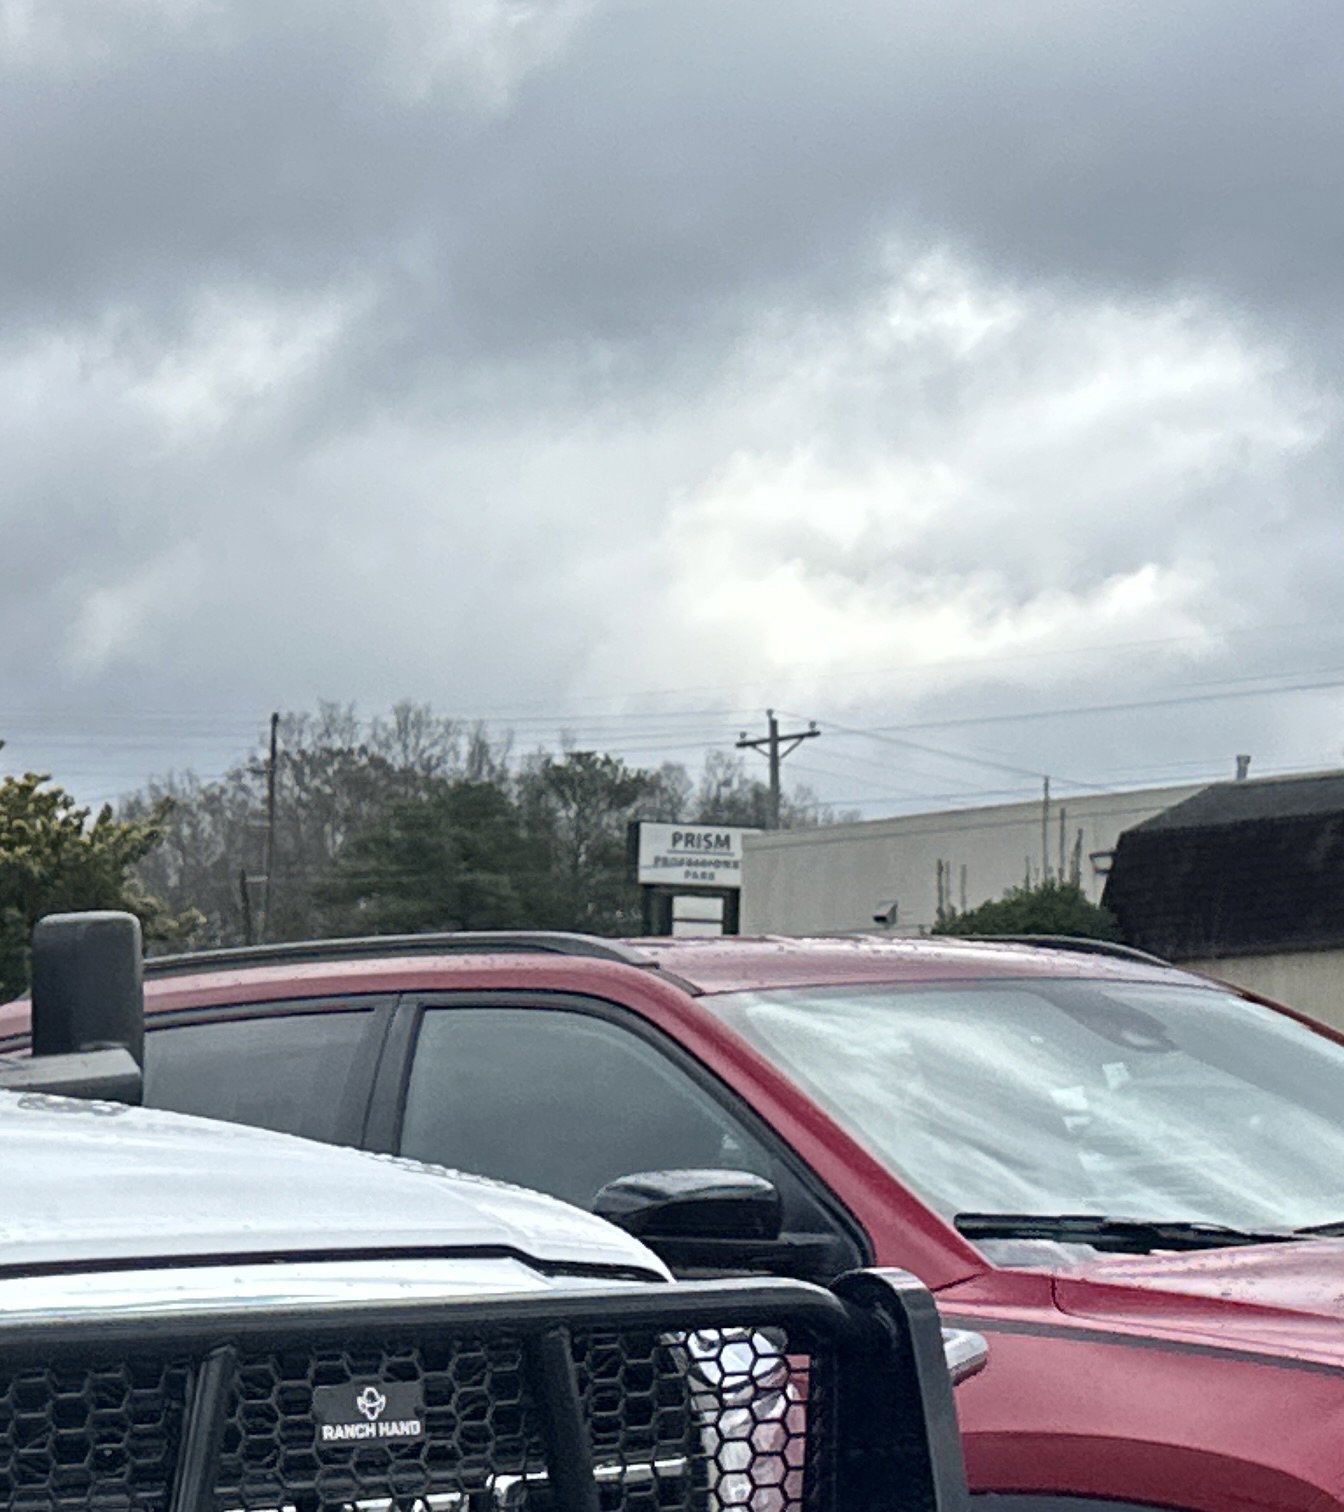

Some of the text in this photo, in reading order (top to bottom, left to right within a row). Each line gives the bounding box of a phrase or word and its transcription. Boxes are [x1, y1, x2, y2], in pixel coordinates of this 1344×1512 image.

[672, 831, 731, 850] PRISM
[322, 1420, 421, 1440] RANCH HAND
